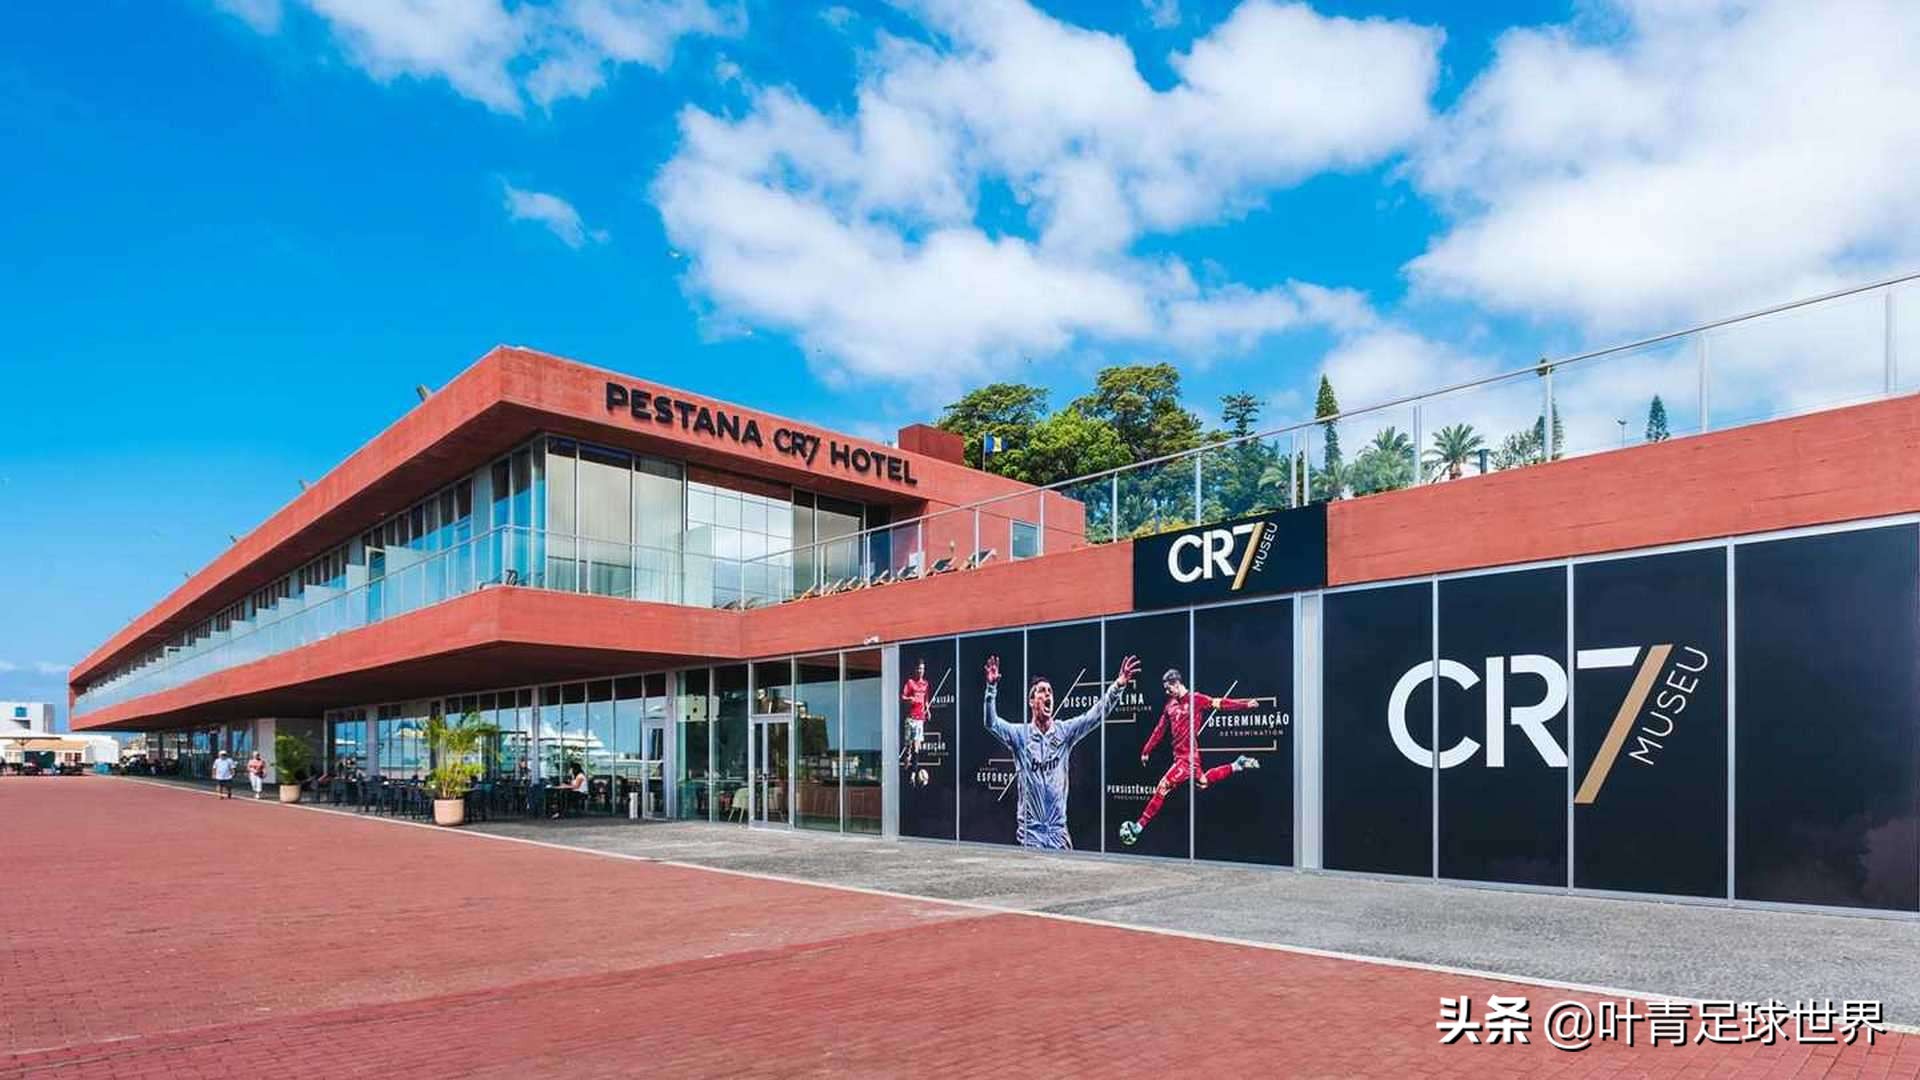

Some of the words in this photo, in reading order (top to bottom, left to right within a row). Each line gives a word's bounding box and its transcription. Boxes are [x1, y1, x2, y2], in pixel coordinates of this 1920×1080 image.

[606, 382, 763, 448] PESTANA
[773, 428, 821, 466] CR7
[829, 441, 917, 485] HOTEL
[1168, 521, 1265, 590] CR7
[1252, 522, 1278, 572] MUSEU
[1208, 711, 1290, 728] DETERMINAÇÃO
[1388, 644, 1673, 804] CR7
[1628, 645, 1708, 765] MUSEU
